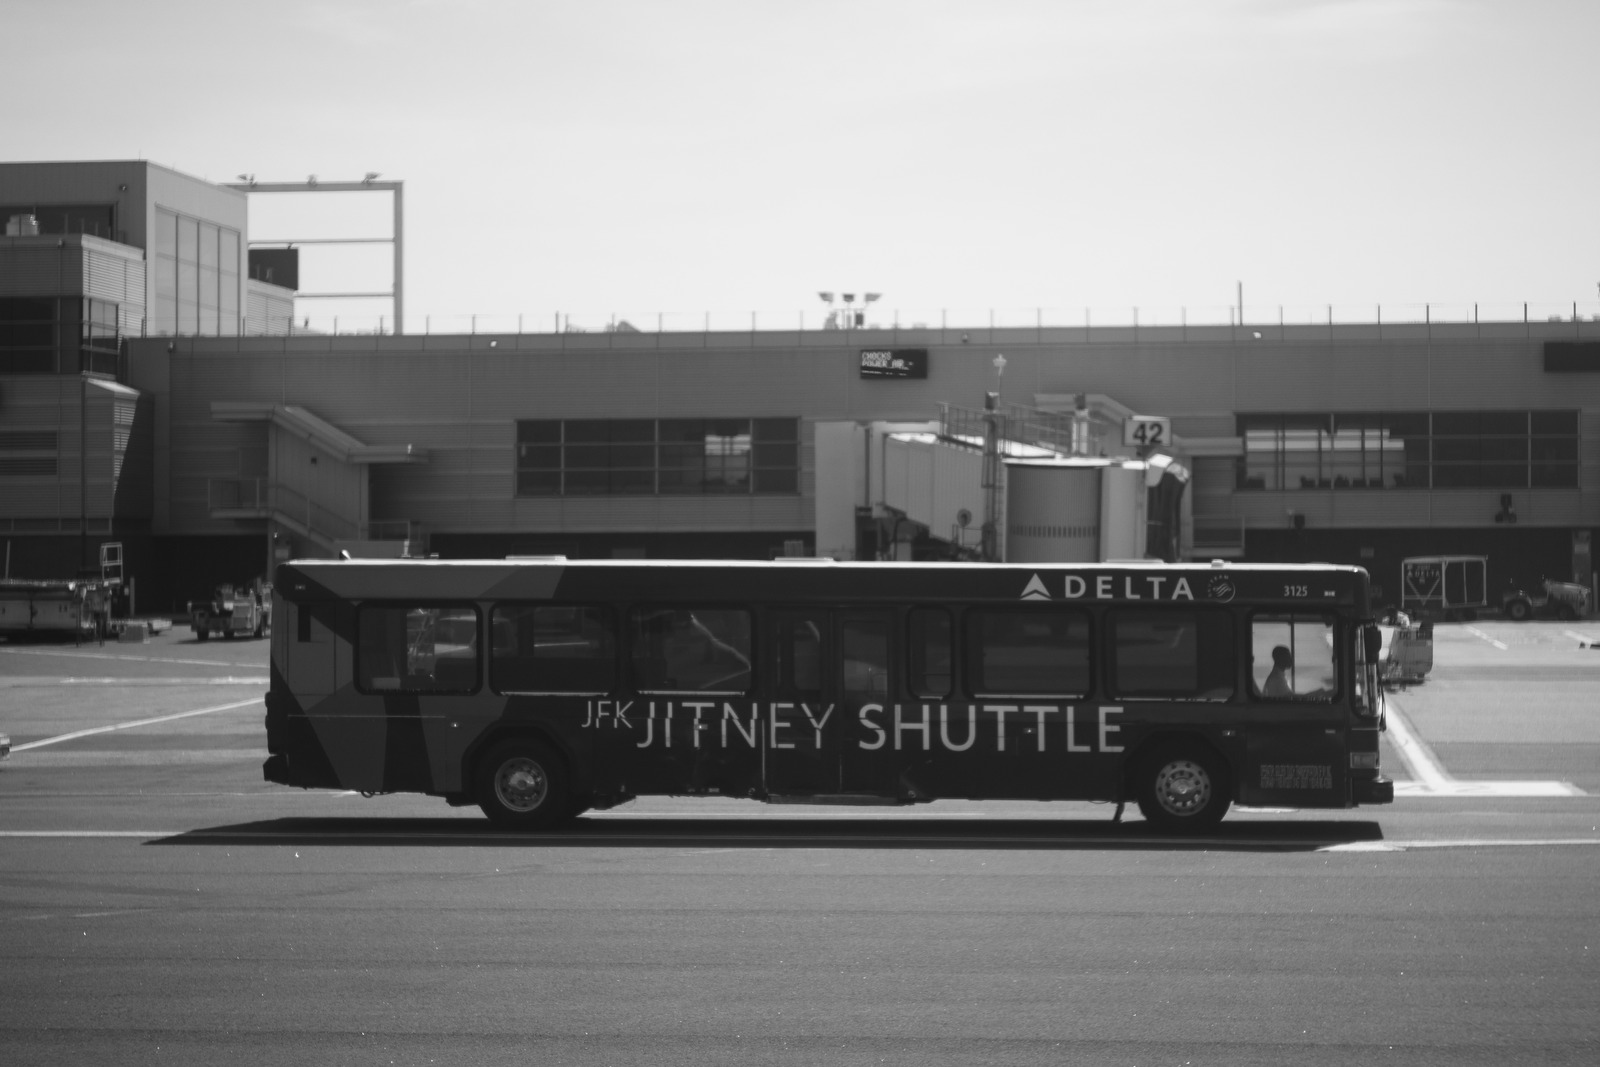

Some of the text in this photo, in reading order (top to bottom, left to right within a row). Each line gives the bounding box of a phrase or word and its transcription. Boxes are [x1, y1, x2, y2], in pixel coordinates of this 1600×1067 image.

[862, 351, 892, 360] CHOCKS
[1132, 422, 1163, 443] 42
[1065, 576, 1194, 600] DELTA
[1283, 585, 1308, 597] 3125
[581, 701, 1125, 753] JFK JITNEY SHUTTLE
